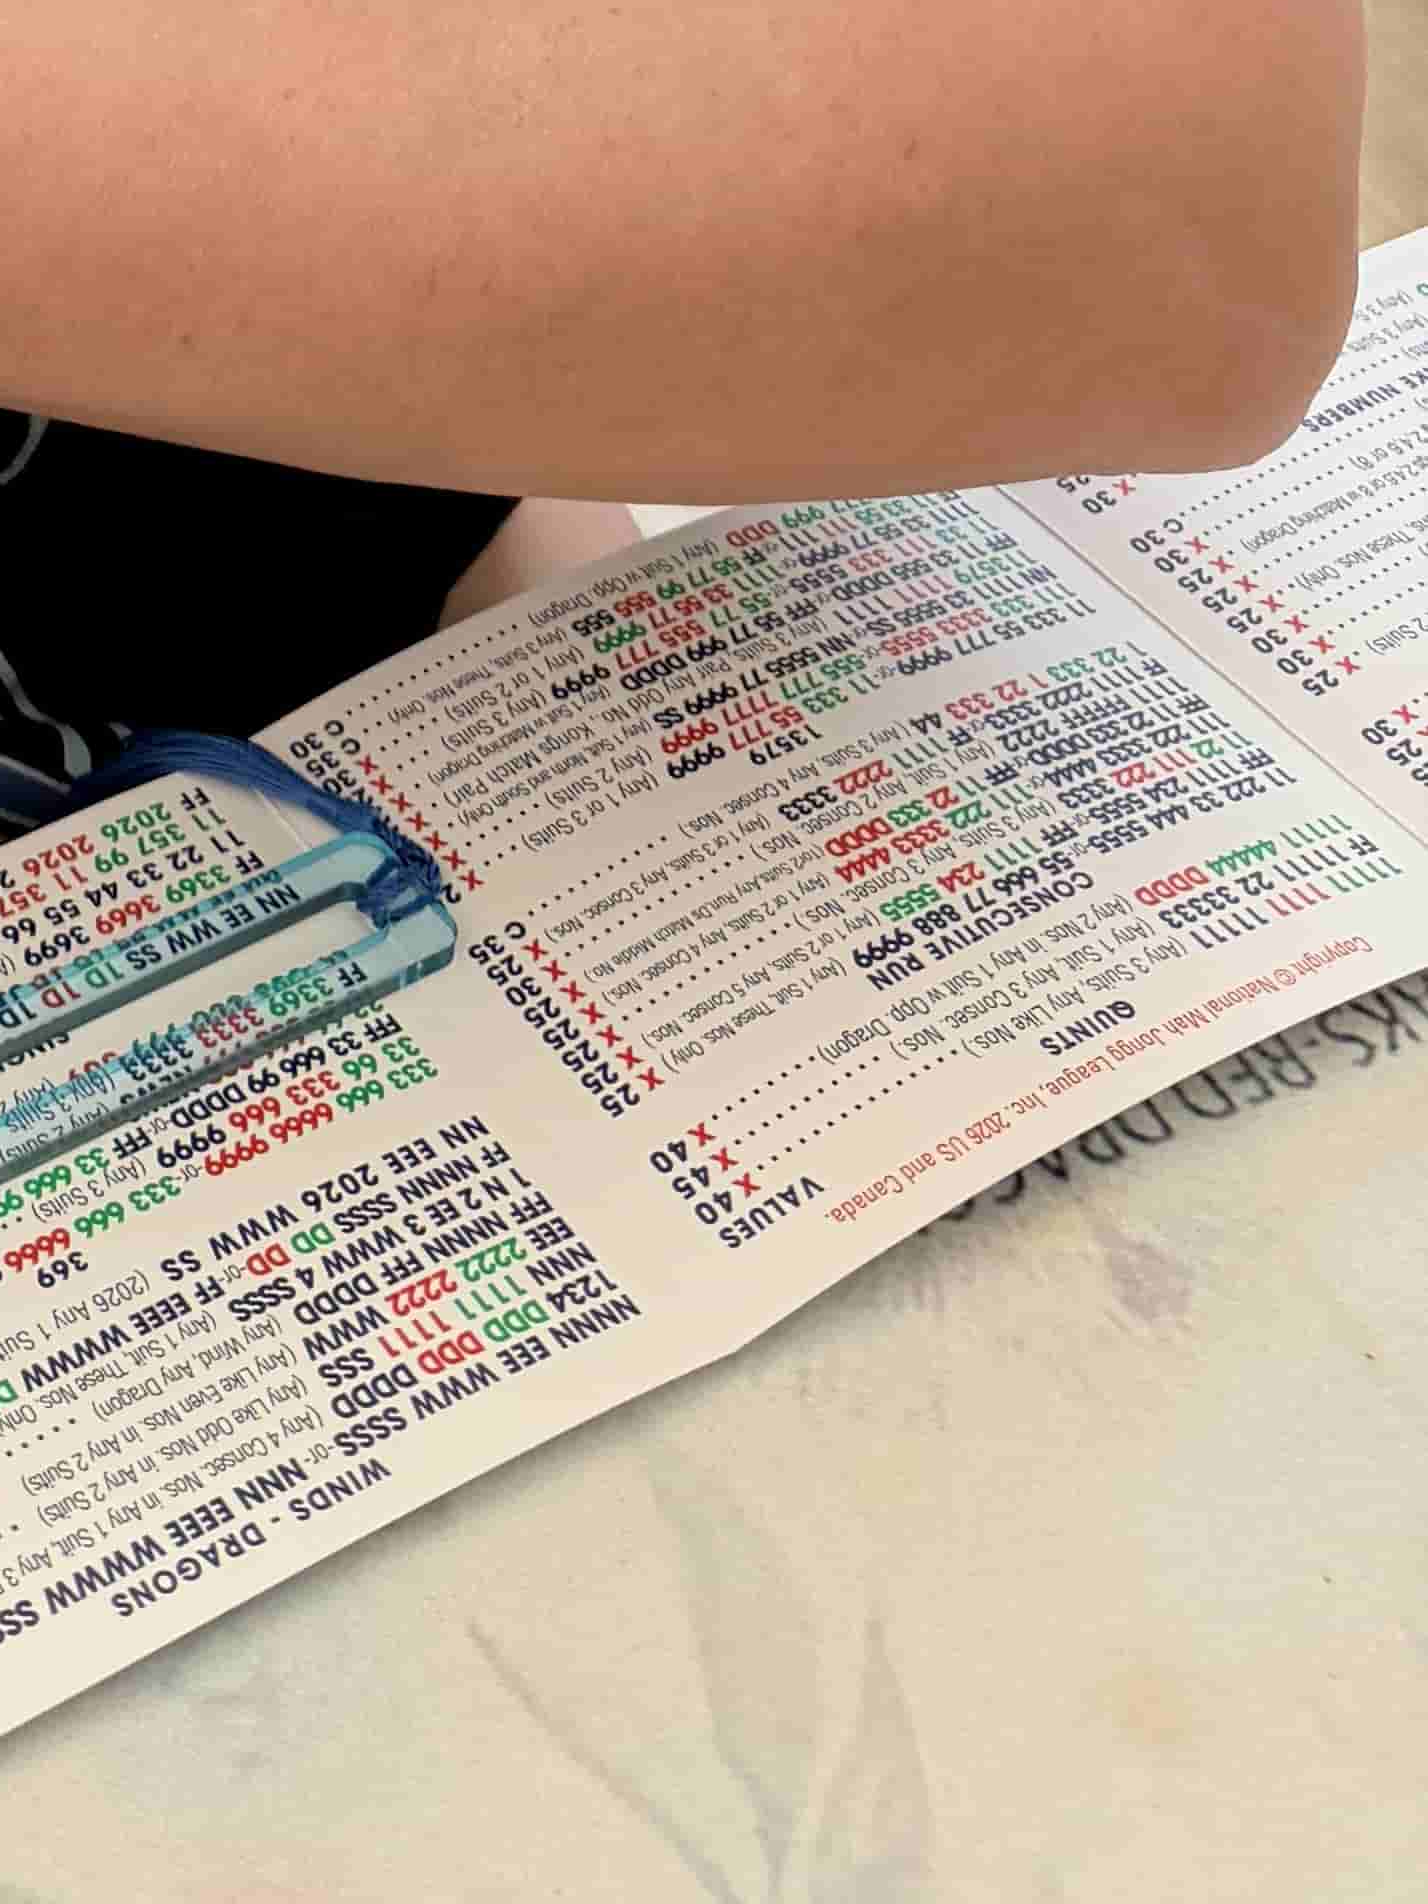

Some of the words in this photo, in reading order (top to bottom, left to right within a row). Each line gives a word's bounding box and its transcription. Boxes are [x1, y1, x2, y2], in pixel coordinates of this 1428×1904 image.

[1130, 527, 1162, 557] 30
[1163, 513, 1183, 536] C
[747, 718, 821, 770] 13579
[179, 783, 208, 813] FF
[100, 795, 170, 848] 2026
[22, 830, 93, 882] 2026
[1327, 854, 1401, 897] 11111
[924, 865, 1092, 964] CONSECUTIVE
[1265, 881, 1329, 920] 1111
[1190, 903, 1267, 952] 11111
[866, 948, 923, 993] RUN
[1132, 955, 1145, 976] 3
[1144, 931, 1186, 971] (Any
[1290, 931, 1372, 980] Copyright
[1080, 957, 1132, 1001] Suits,
[1204, 971, 1277, 1022] National
[1276, 963, 1296, 989] ©
[1010, 1003, 1047, 1038] Like
[1046, 982, 1082, 1018] Any
[962, 1019, 1012, 1062] Nos.)
[1039, 995, 1135, 1059] QUINTS
[1109, 1021, 1165, 1067] Jongg
[1164, 1005, 1205, 1041] Mah
[341, 1049, 377, 1084] 66
[379, 1031, 419, 1067] 33
[285, 1065, 339, 1109] 333
[387, 1051, 437, 1094] 333
[1038, 1049, 1112, 1104] League,
[228, 1092, 282, 1136] 666
[335, 1074, 386, 1117] 666
[1004, 1088, 1043, 1124] Inc.
[268, 1097, 335, 1148] 6666
[439, 1110, 486, 1152] NN
[965, 1108, 1006, 1147] 2026
[154, 1118, 226, 1172] 9999
[382, 1134, 433, 1177] EEE
[478, 1137, 507, 1169] FF
[936, 1133, 966, 1163] US
[88, 1177, 102, 1199] 3
[101, 1154, 145, 1193] (Any
[128, 1129, 270, 1215] 9999-or-333
[301, 1160, 378, 1217] 2026
[396, 1150, 476, 1208] NNNN
[732, 1169, 759, 1200] X
[899, 1148, 938, 1188] and
[32, 1183, 88, 1228] Suits)
[73, 1197, 126, 1241] 666
[334, 1189, 395, 1237] SSSS
[506, 1186, 551, 1227] FFF
[694, 1187, 736, 1228] 40
[718, 1170, 822, 1252] VALUES
[824, 1170, 902, 1230] Canada.
[3, 1224, 71, 1276] 6666
[207, 1198, 296, 1262] WWW
[290, 1218, 334, 1258] DD
[423, 1207, 506, 1266] NNNN
[34, 1248, 87, 1291] 369
[159, 1246, 200, 1286] SS
[190, 1239, 289, 1307] DD-or-FF
[378, 1248, 422, 1287] FFF
[90, 1267, 152, 1318] (2026
[292, 1269, 377, 1329] DDDD
[545, 1264, 614, 1318] 1234
[36, 1319, 49, 1342] 1
[51, 1297, 91, 1335] Any
[130, 1289, 189, 1337] EEEE
[239, 1311, 282, 1351] (Any
[482, 1296, 548, 1349] DDD
[550, 1288, 638, 1353] NNNN
[19, 1321, 127, 1393] WWWW
[159, 1354, 194, 1390] Any
[191, 1332, 243, 1375] Wind,
[417, 1328, 482, 1380] DDD
[498, 1332, 548, 1378] EEE
[90, 1370, 162, 1424] Dragon)
[329, 1360, 416, 1423] DDDD
[409, 1357, 498, 1421] WWW
[267, 1427, 281, 1449] 4
[278, 1403, 323, 1444] (Any
[200, 1433, 268, 1484] Consec.
[232, 1403, 406, 1513] SSSS-or-NNN
[142, 1490, 162, 1516] in
[159, 1468, 201, 1504] Nos.
[288, 1454, 390, 1523] WINDS
[93, 1521, 104, 1542] 1
[105, 1497, 142, 1534] Any
[164, 1494, 232, 1549] EEEE
[271, 1515, 278, 1524] -
[14, 1544, 52, 1581] Any
[49, 1523, 93, 1564] Suit,
[1, 1565, 17, 1589] 3
[42, 1529, 165, 1615] WWWW
[109, 1520, 265, 1621] DRAGONS
